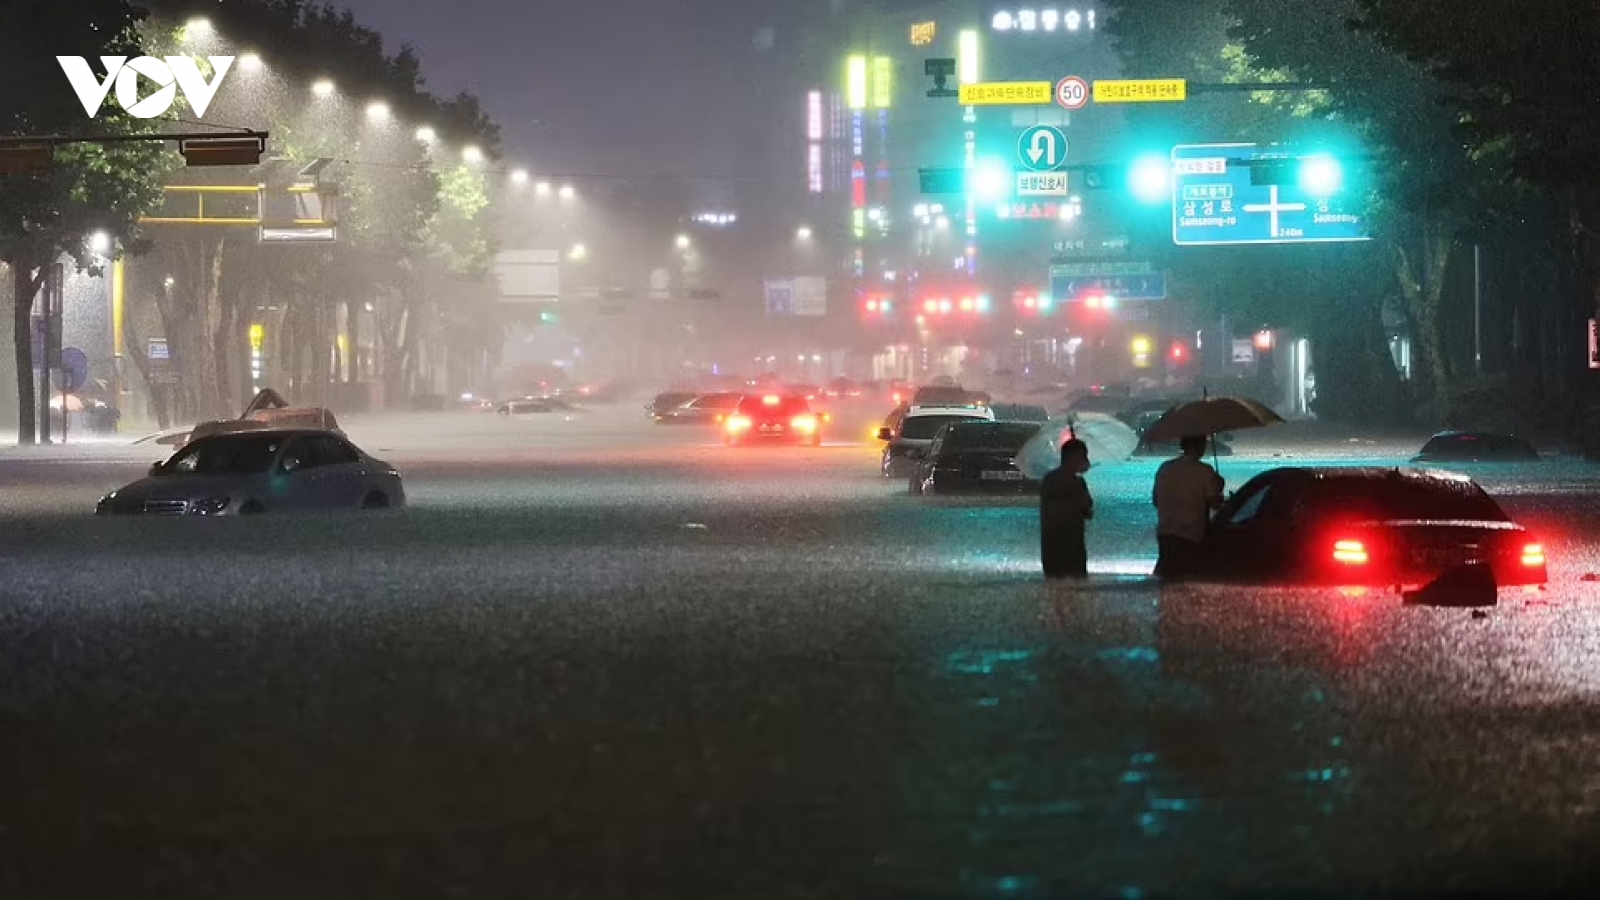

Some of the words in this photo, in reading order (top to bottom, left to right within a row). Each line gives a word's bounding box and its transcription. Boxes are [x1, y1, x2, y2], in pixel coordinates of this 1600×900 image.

[1063, 84, 1081, 99] 50
[1020, 175, 1065, 191] 보행신호시
[1184, 199, 1233, 216] 삼성로
[1180, 216, 1237, 227] Samseong-ro
[1279, 227, 1304, 238] 240m
